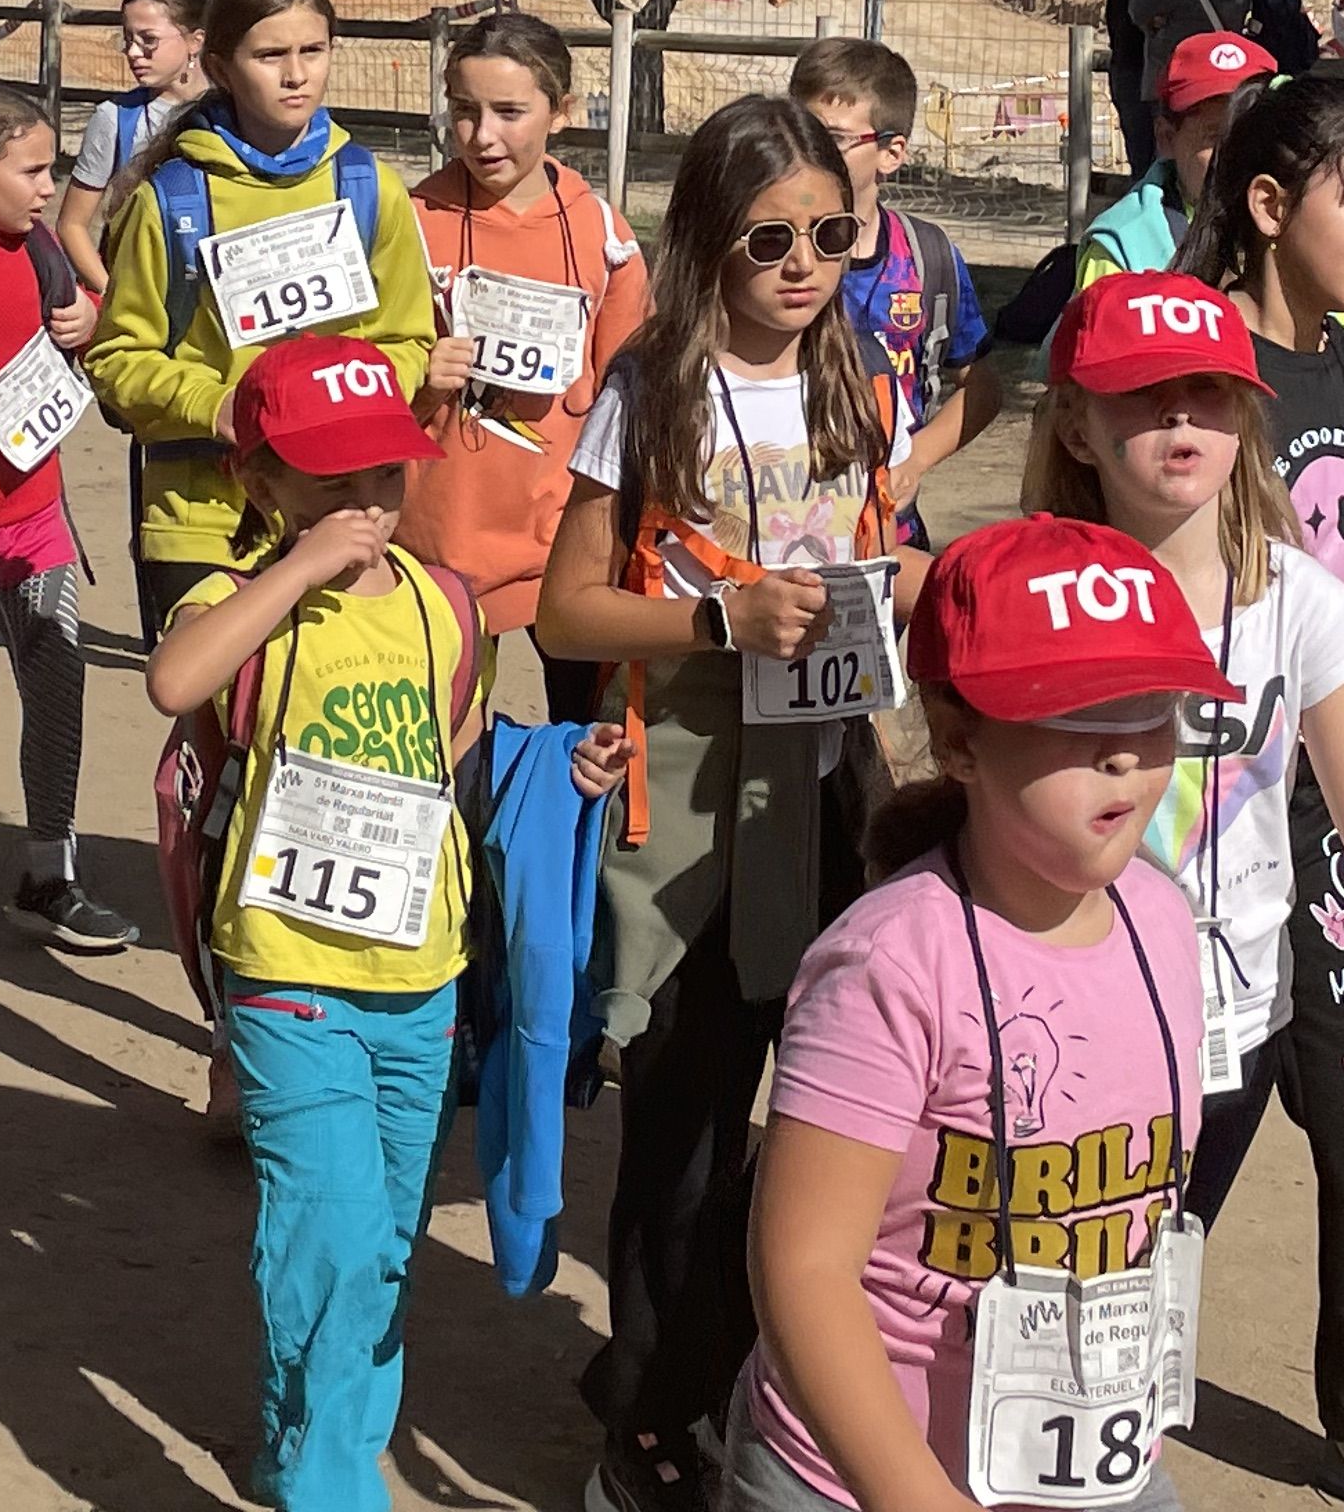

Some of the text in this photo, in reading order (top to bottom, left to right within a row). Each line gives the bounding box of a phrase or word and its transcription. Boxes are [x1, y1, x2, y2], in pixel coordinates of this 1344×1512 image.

[1216, 50, 1240, 65] M
[253, 274, 334, 329] 193
[1128, 294, 1224, 341] TOT
[472, 335, 542, 381] 159
[312, 359, 394, 403] TOT
[22, 389, 74, 450] 105
[1028, 563, 1156, 630] TOT
[315, 653, 370, 679] ESCOLA
[787, 651, 862, 709] 102
[314, 776, 327, 789] 51
[330, 781, 364, 800] Marxa
[316, 794, 331, 807] de
[268, 847, 382, 920] 115
[1098, 1301, 1148, 1320] Marxa
[1084, 1324, 1151, 1346] de Regu
[1088, 1375, 1134, 1399] TERUEL
